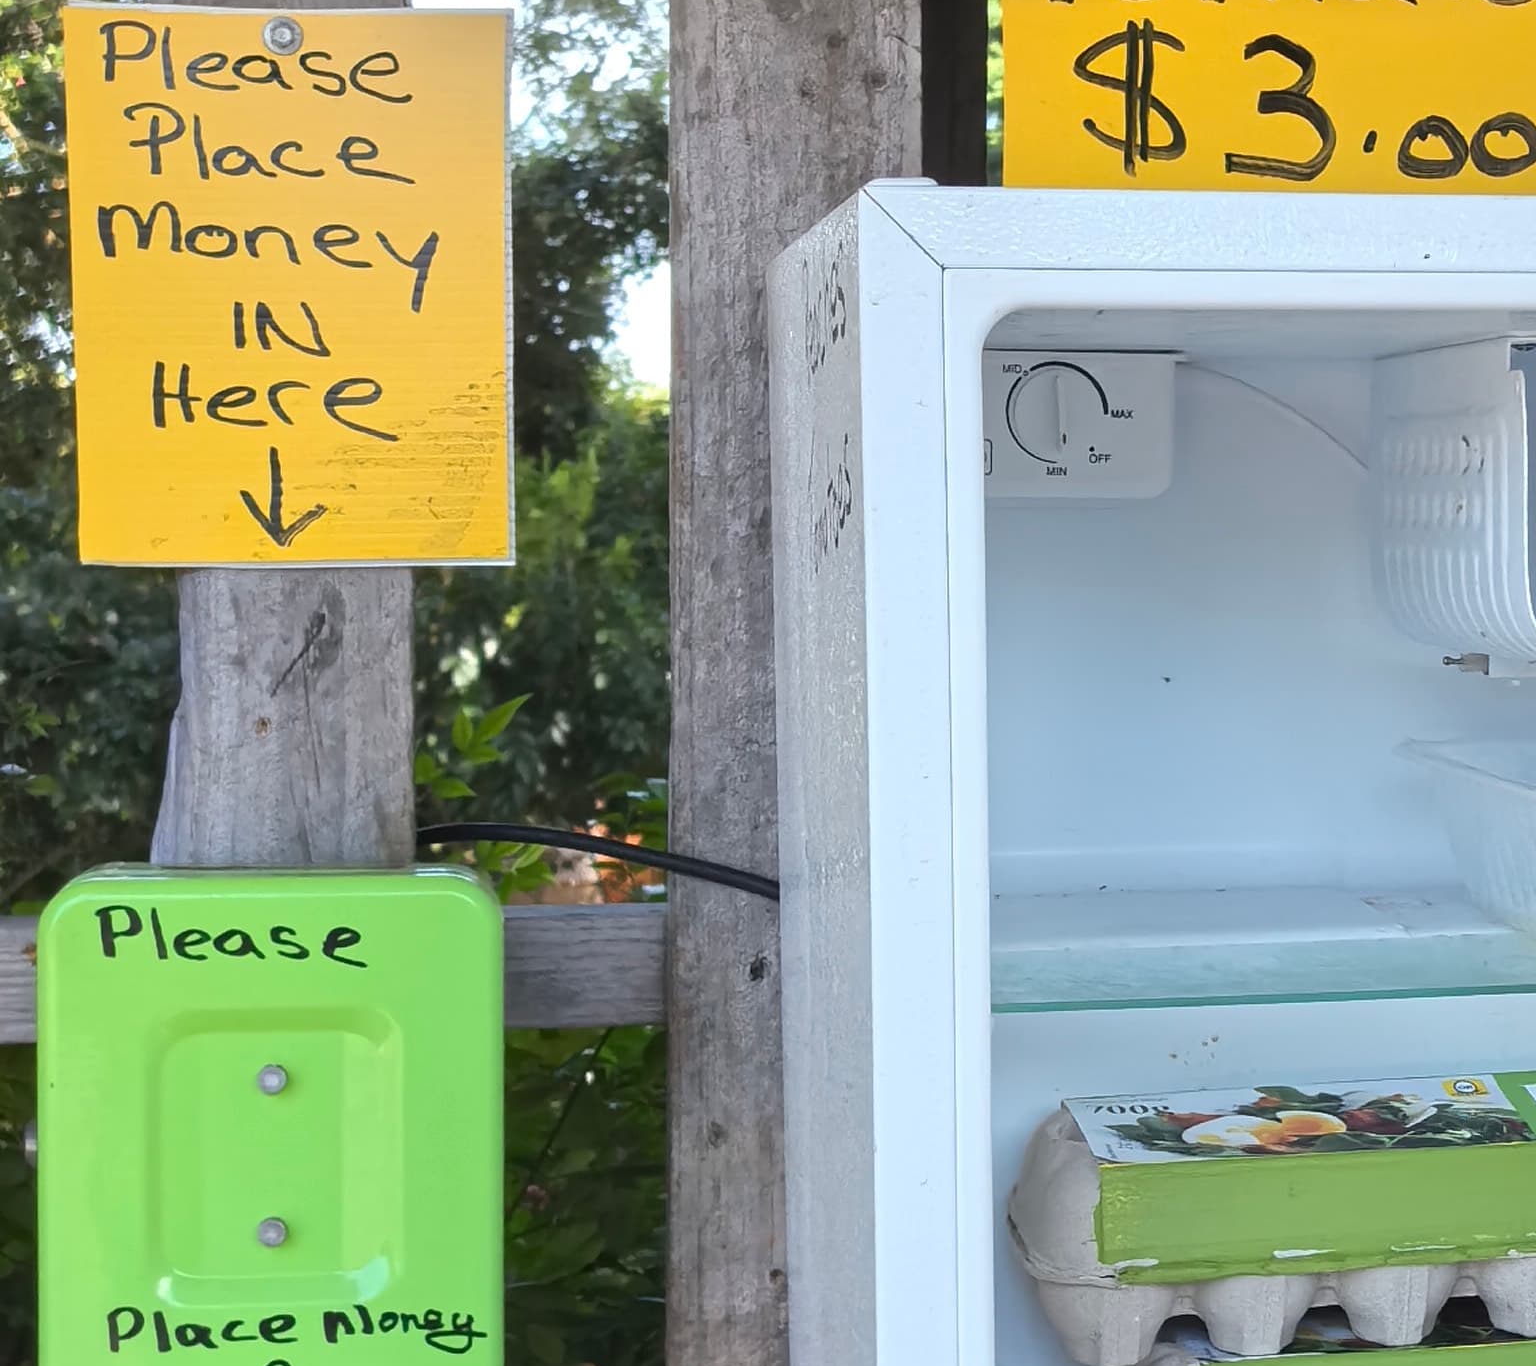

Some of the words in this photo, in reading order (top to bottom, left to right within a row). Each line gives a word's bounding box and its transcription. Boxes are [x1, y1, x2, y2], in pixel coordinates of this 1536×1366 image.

[100, 20, 414, 104] Please
[123, 102, 416, 184] Place
[233, 301, 331, 357] IN
[1002, 363, 1023, 374] MID
[152, 361, 400, 441] Here
[1110, 409, 1134, 420] MAX
[1046, 466, 1068, 476] MIN
[1088, 453, 1112, 464] OFF
[95, 904, 368, 968] Please
[107, 1306, 299, 1353] Place
